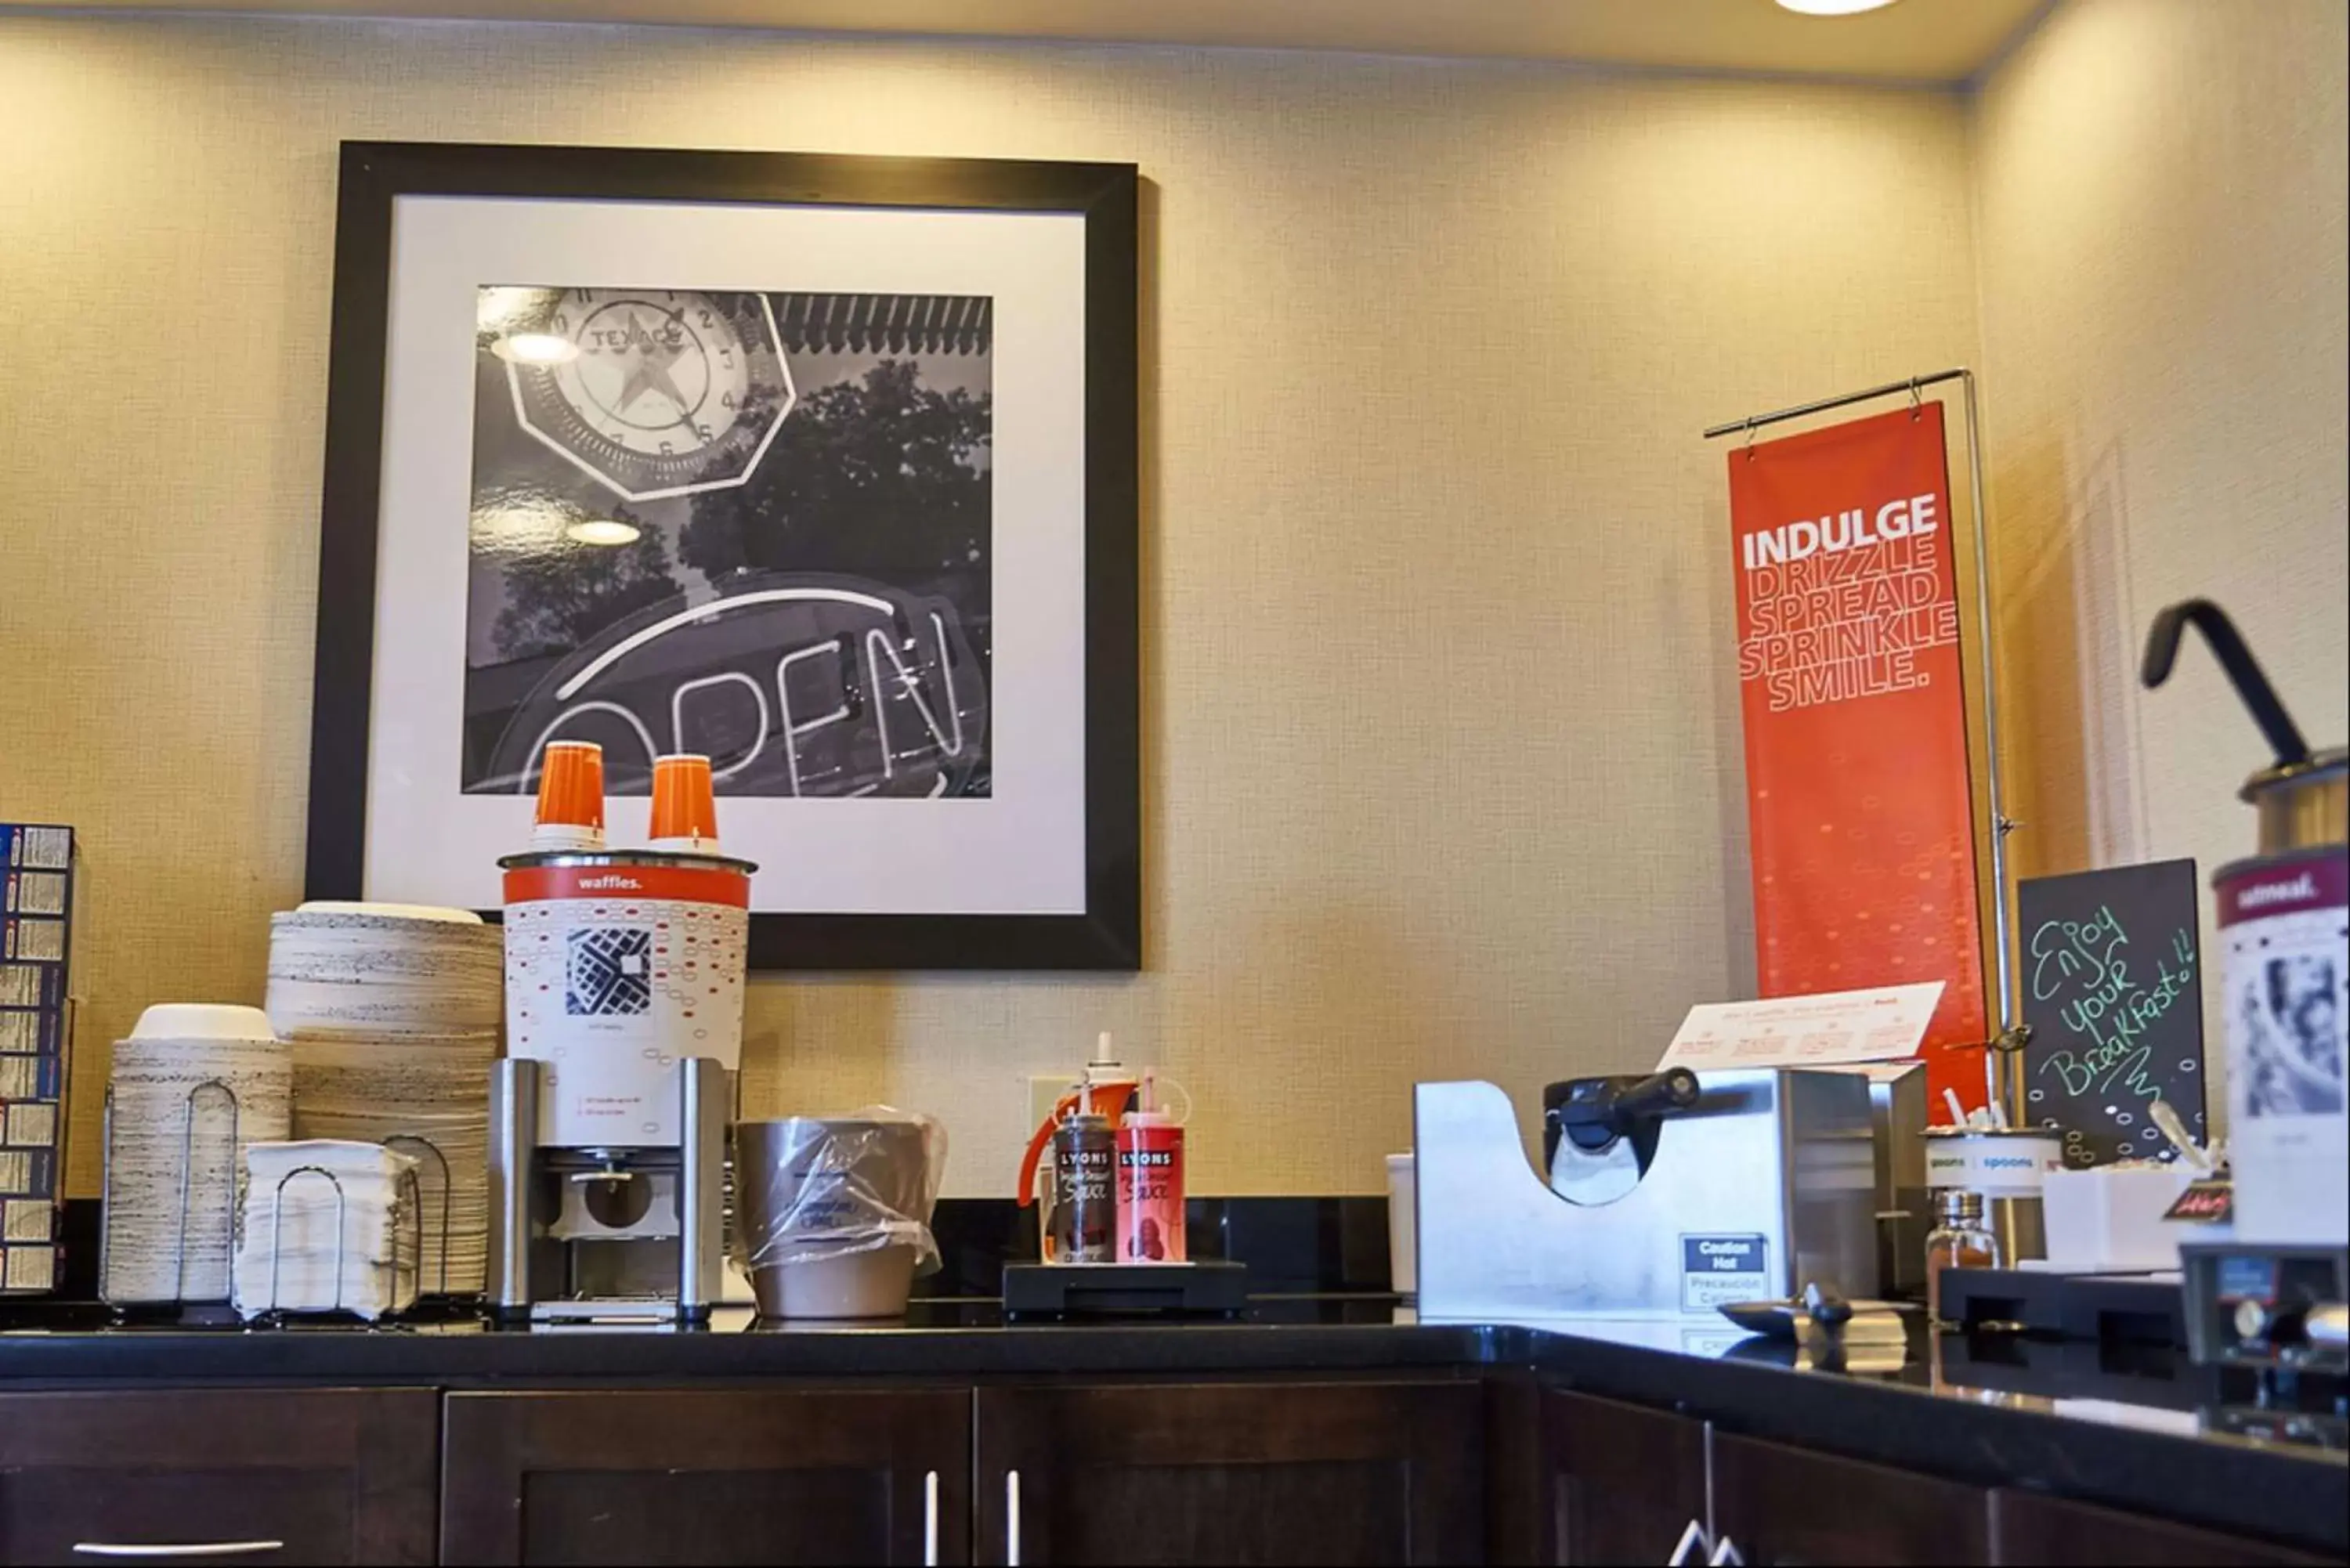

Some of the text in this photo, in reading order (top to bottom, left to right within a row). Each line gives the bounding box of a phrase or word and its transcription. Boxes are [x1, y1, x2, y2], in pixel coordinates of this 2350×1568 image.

[1744, 493, 1938, 569] INDULGE
[1748, 532, 1938, 603] DRIZZLE
[1749, 568, 1940, 641] SPREAD
[1739, 601, 1958, 681] SPRINKLE
[1767, 648, 1930, 712] SMILE.
[578, 873, 644, 891] waffles.
[2031, 905, 2128, 1001] Enjoy
[1061, 1152, 1108, 1165] LYONS
[1121, 1152, 1171, 1165] LYONS
[1983, 1157, 2033, 1171] spoons
[1698, 1241, 1751, 1255] Caution
[1712, 1256, 1737, 1269] Hot
